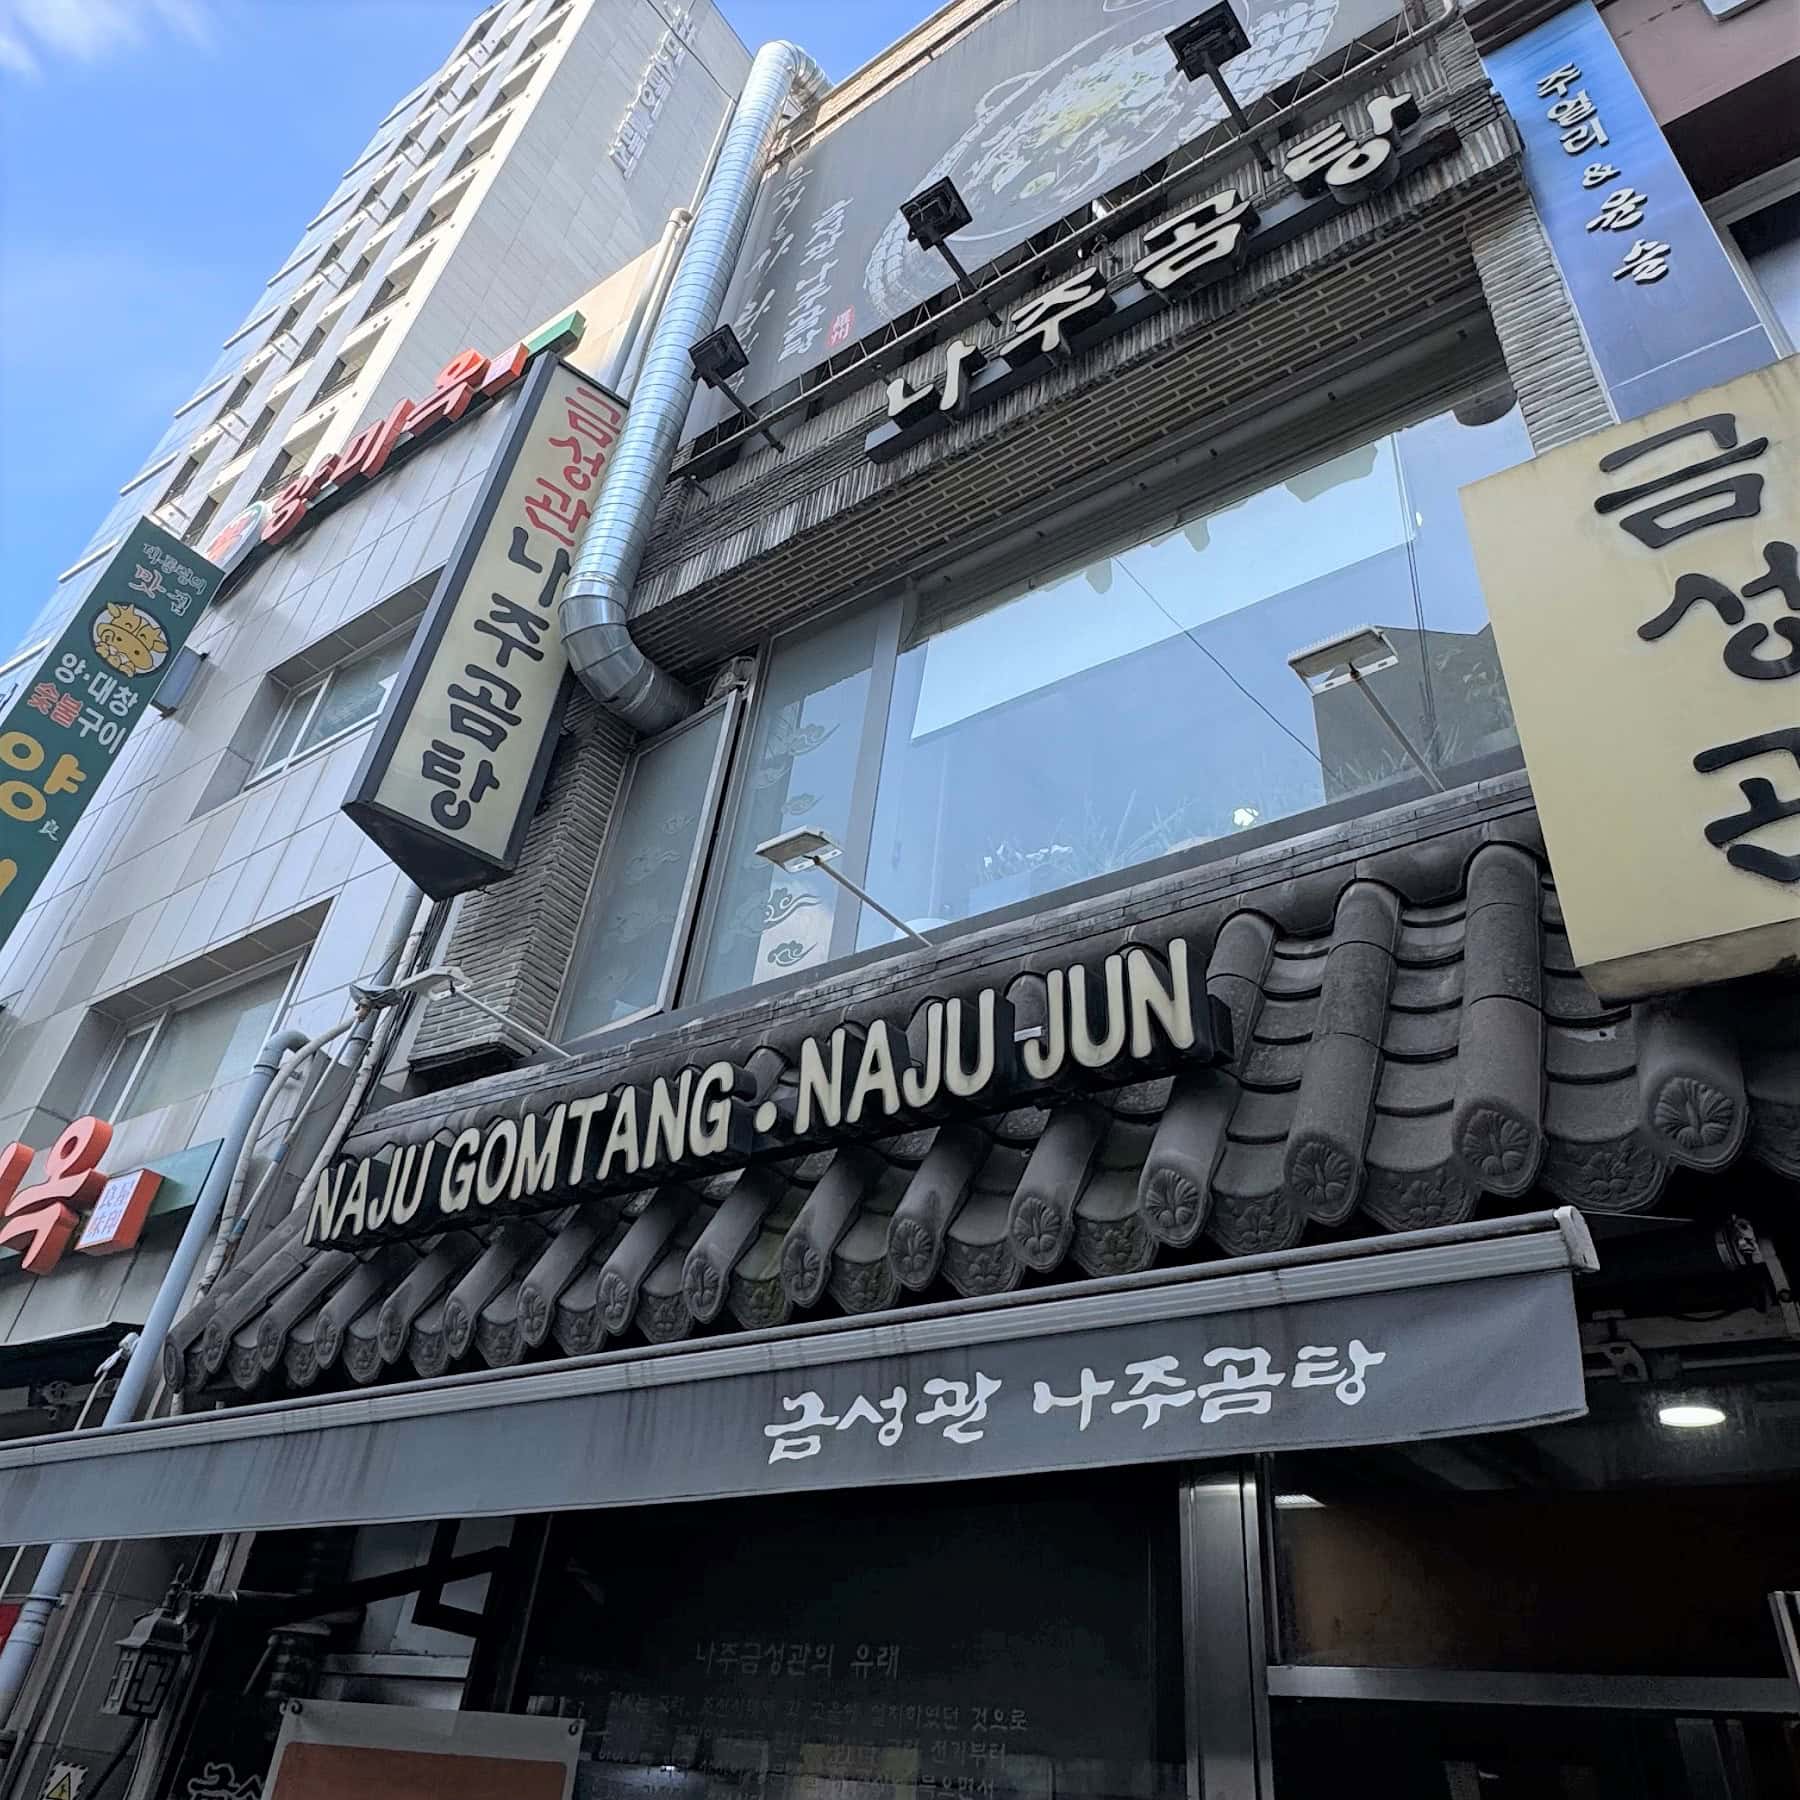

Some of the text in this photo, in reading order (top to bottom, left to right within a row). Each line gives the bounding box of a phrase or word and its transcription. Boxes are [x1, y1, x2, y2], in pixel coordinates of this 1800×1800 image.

[1582, 163, 1621, 188] &
[777, 258, 839, 363] 나주곰탕
[886, 92, 1414, 419] 나주곰탕
[261, 347, 489, 546] 양미옥
[421, 386, 622, 831] 금성관 나주곰탕
[27, 681, 127, 755] 숯불구이
[303, 1138, 435, 1247] NAJU
[440, 1060, 737, 1214] GOMTANG
[793, 988, 996, 1135] NAJU
[1022, 937, 1196, 1080] JUN
[764, 1339, 1387, 1464] 금성관 나주곰탕
[695, 1640, 902, 1681] 나주금성관의 유래
[970, 1707, 1028, 1731] 것으로
